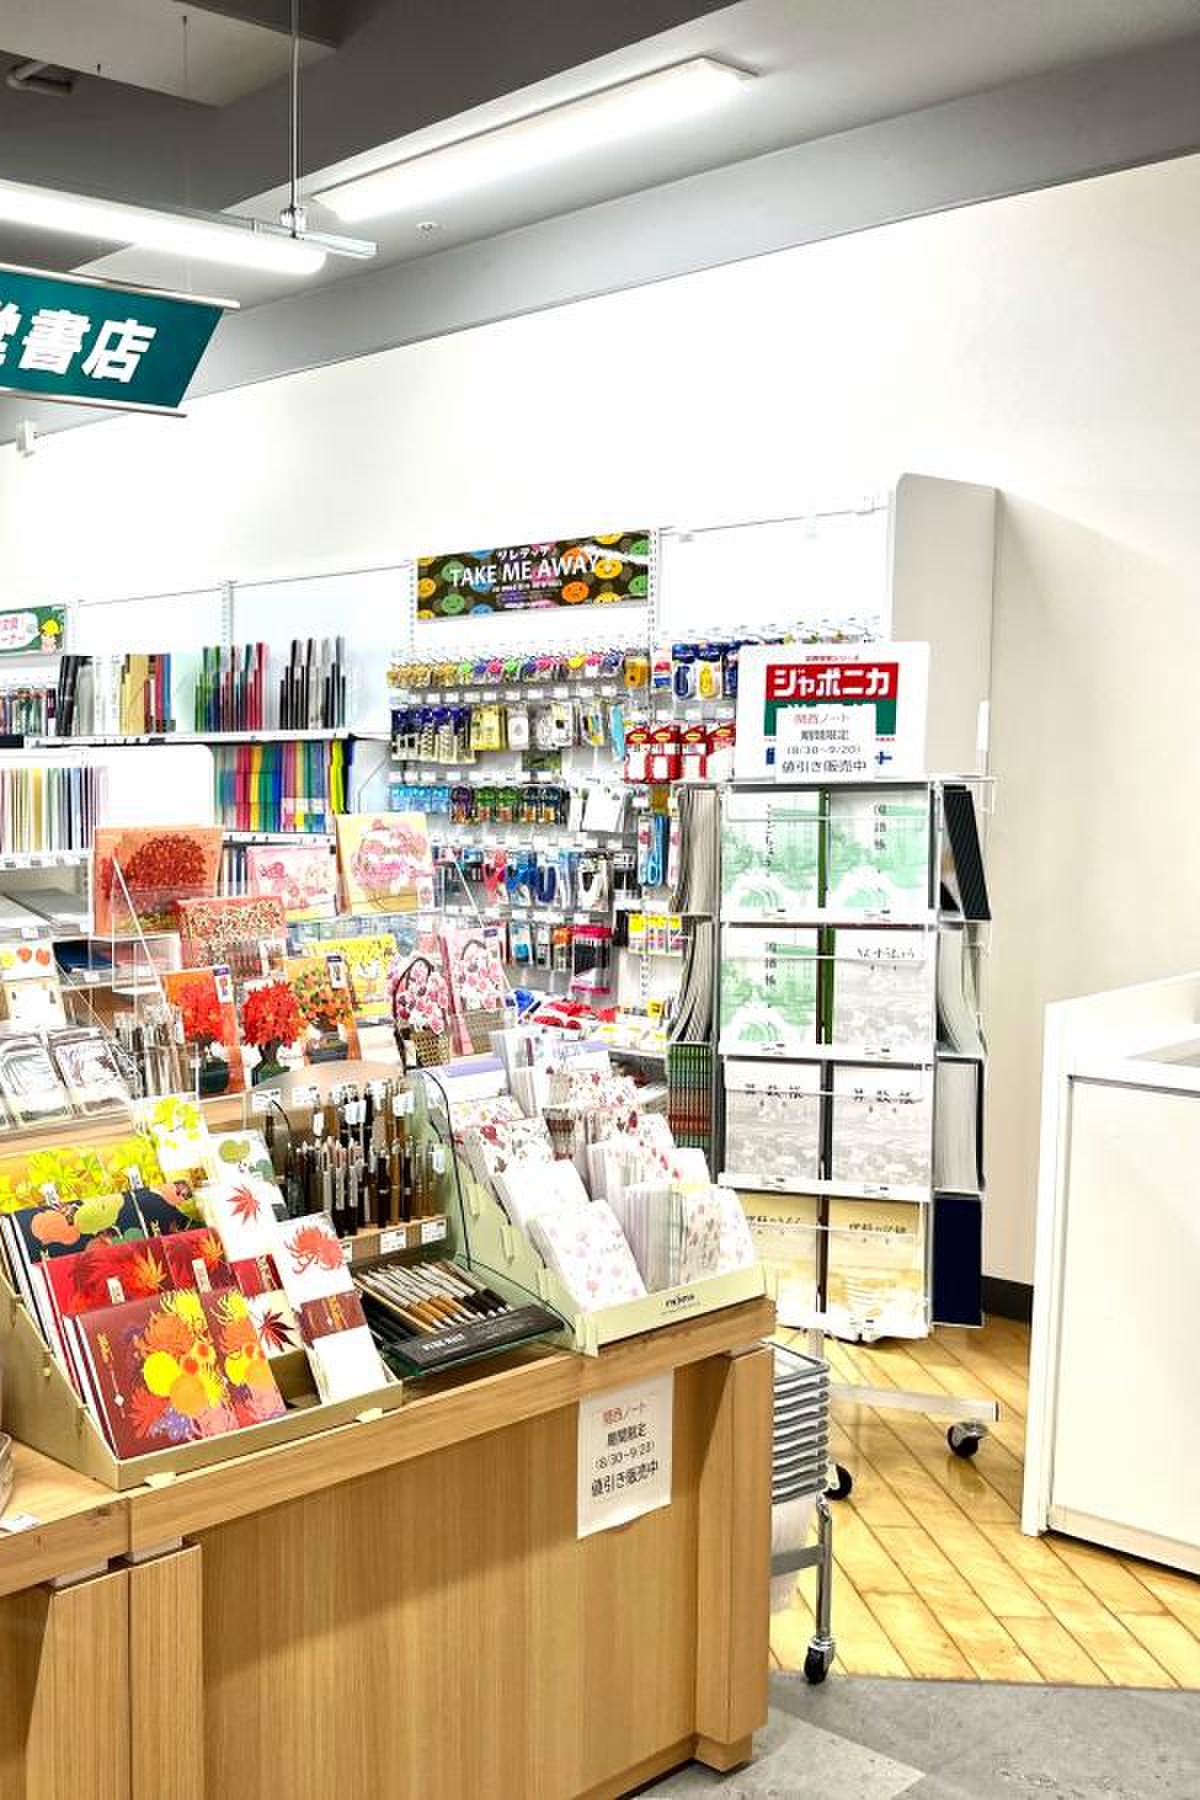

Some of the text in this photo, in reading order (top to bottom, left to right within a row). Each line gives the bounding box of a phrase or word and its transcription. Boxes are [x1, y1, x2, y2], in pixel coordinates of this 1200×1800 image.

[450, 565, 497, 587] TAKE
[502, 560, 533, 582] ME
[538, 554, 600, 579] AWAY
[774, 668, 890, 697] ジャポニカ
[782, 759, 867, 774] 値引き販売中
